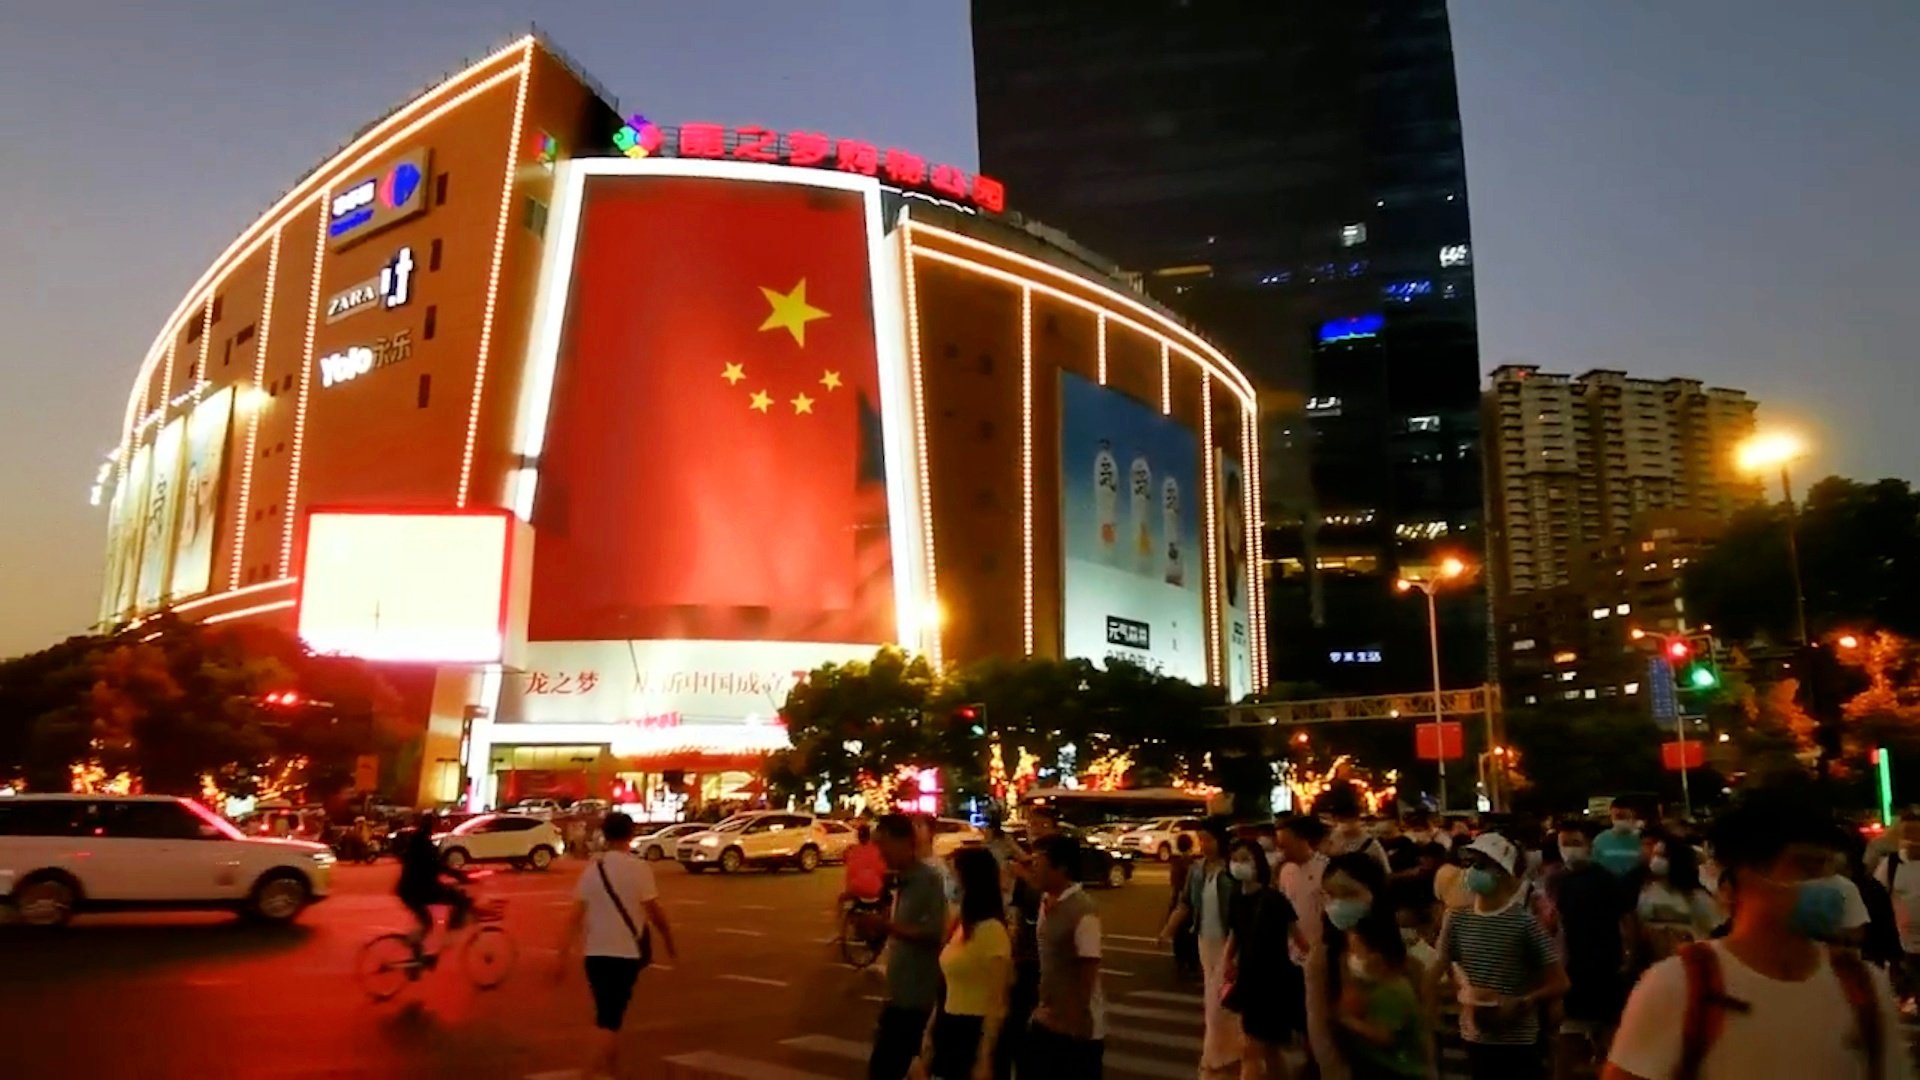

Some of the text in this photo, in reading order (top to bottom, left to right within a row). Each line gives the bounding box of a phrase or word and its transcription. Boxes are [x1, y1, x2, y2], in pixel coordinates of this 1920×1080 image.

[328, 286, 376, 316] ZARA
[524, 671, 599, 696] 龙之梦
